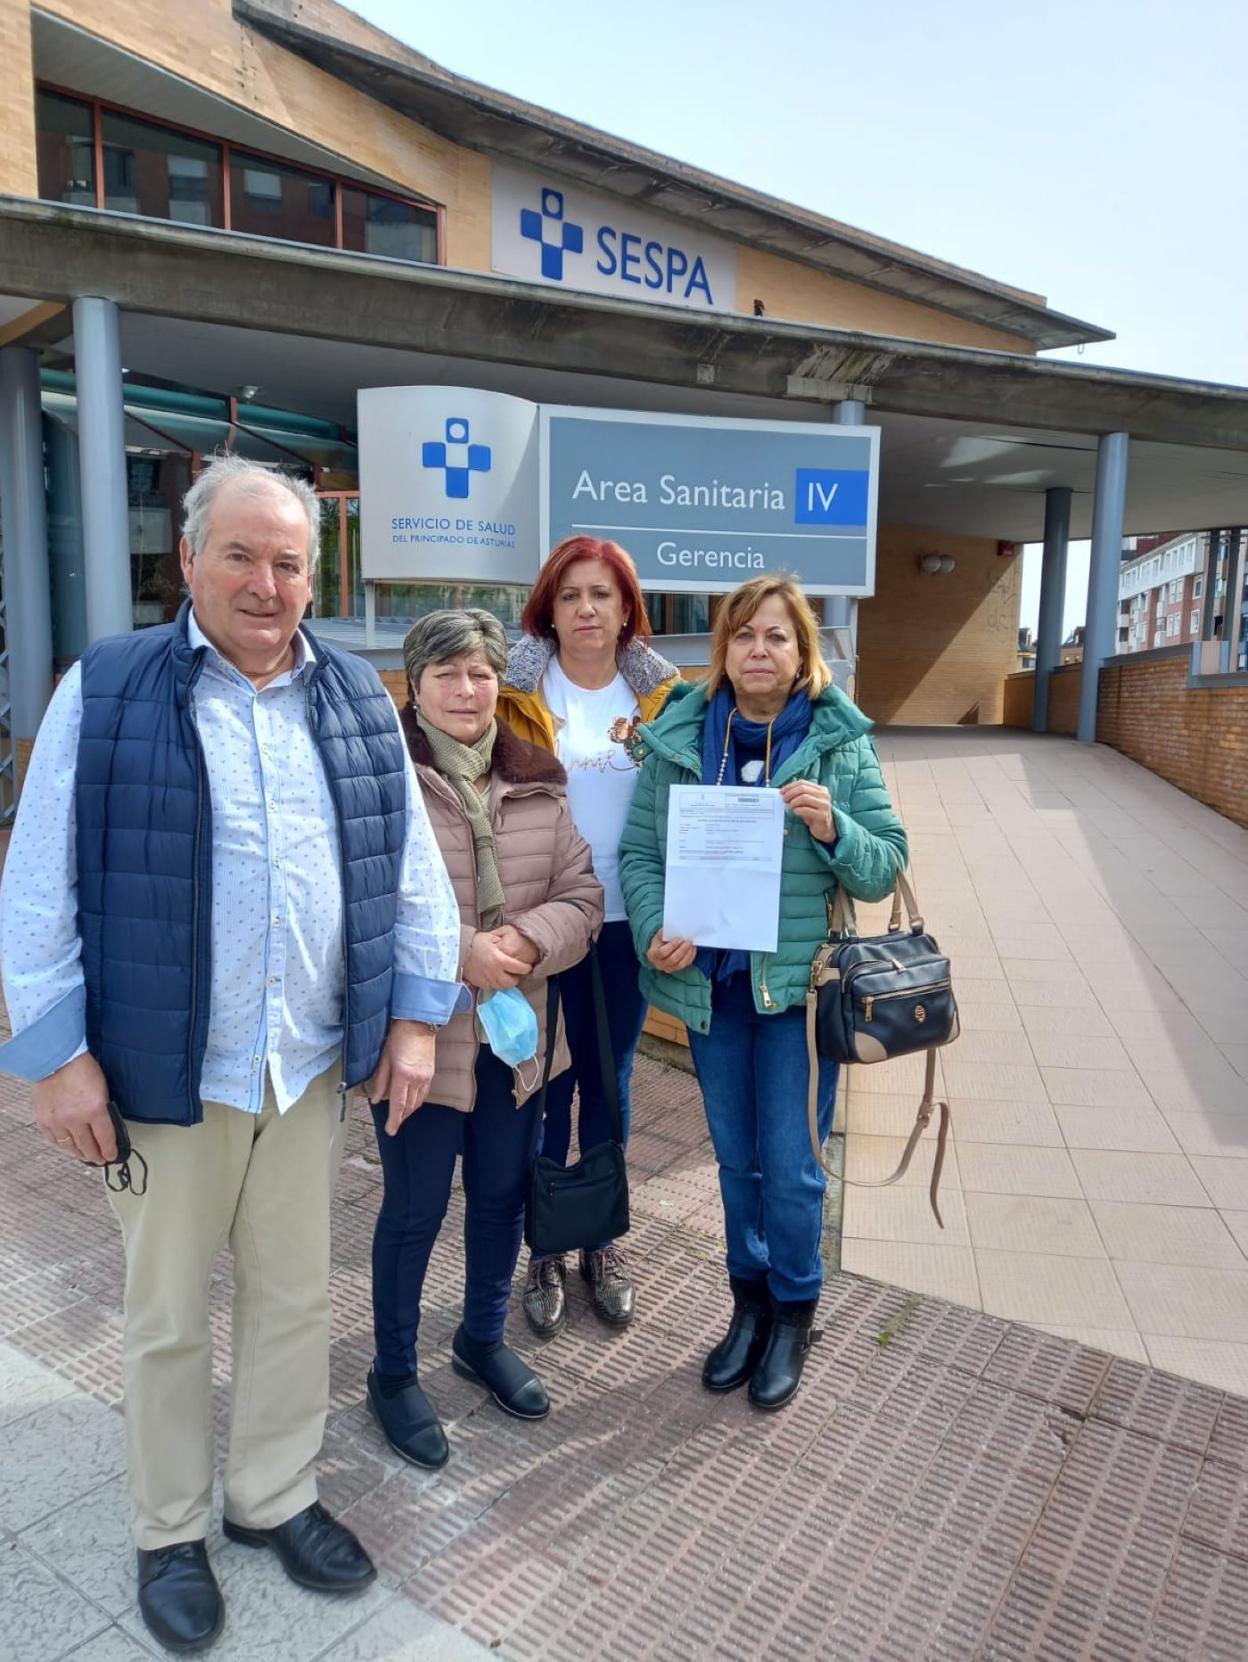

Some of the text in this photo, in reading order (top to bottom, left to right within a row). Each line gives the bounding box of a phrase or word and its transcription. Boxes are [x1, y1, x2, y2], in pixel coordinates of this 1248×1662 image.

[597, 226, 713, 305] SESPA
[572, 469, 839, 512] Area Sanitaria IV
[391, 518, 516, 535] SERVICIO DE SALUD
[392, 535, 408, 543] DEL
[410, 535, 464, 544] PRINCIPADO
[466, 536, 478, 545] DE
[656, 541, 766, 569] Gerencia
